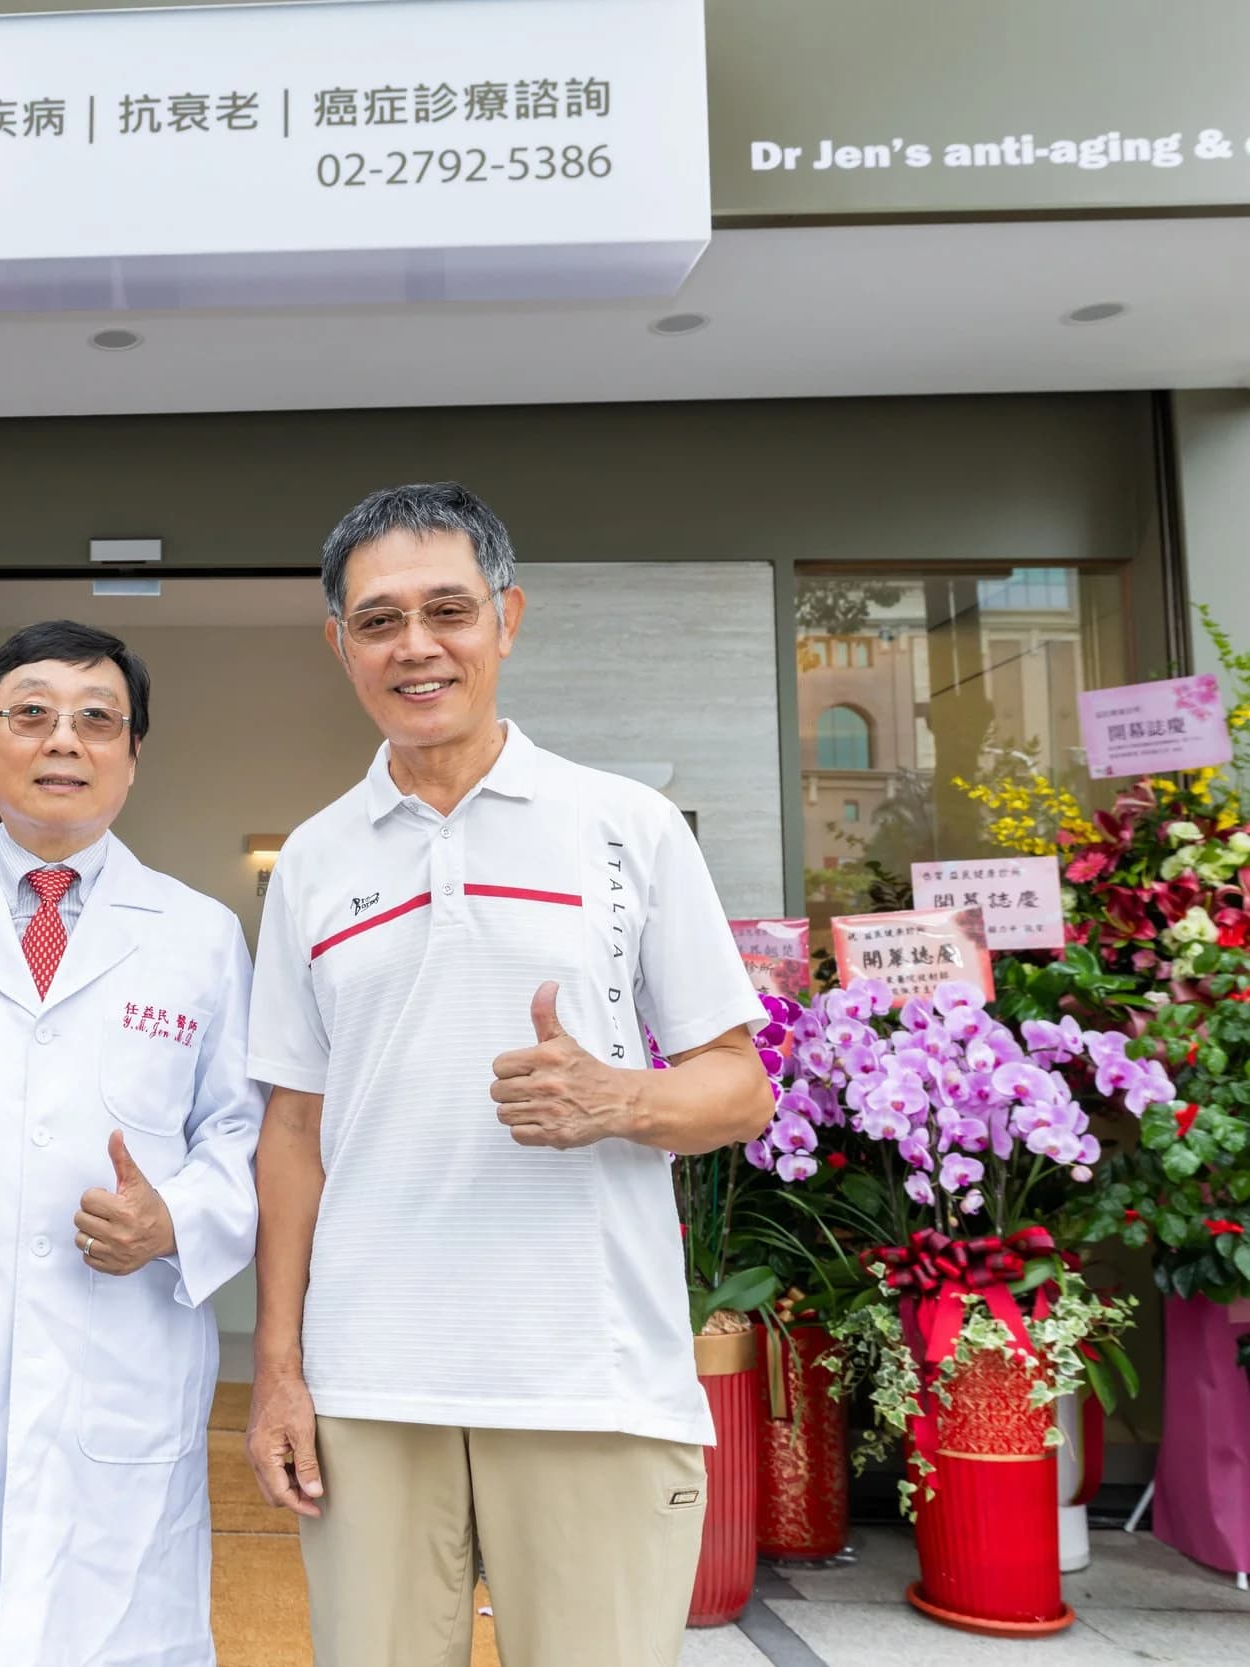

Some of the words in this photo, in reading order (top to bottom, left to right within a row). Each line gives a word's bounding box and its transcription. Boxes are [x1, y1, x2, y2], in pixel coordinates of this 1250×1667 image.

[118, 90, 260, 135] 抗衰老
[313, 76, 612, 128] 癌症診療諮詢
[316, 143, 613, 188] 02-2792-5386
[750, 141, 803, 171] Dr
[813, 138, 932, 170] Jen's
[944, 131, 1184, 169] anti-aging
[1194, 129, 1234, 160] &
[1107, 716, 1188, 742] 開幕誌慶
[606, 839, 627, 959] ITALIA
[124, 1001, 170, 1025] 任益民
[176, 1013, 199, 1034] 醫師
